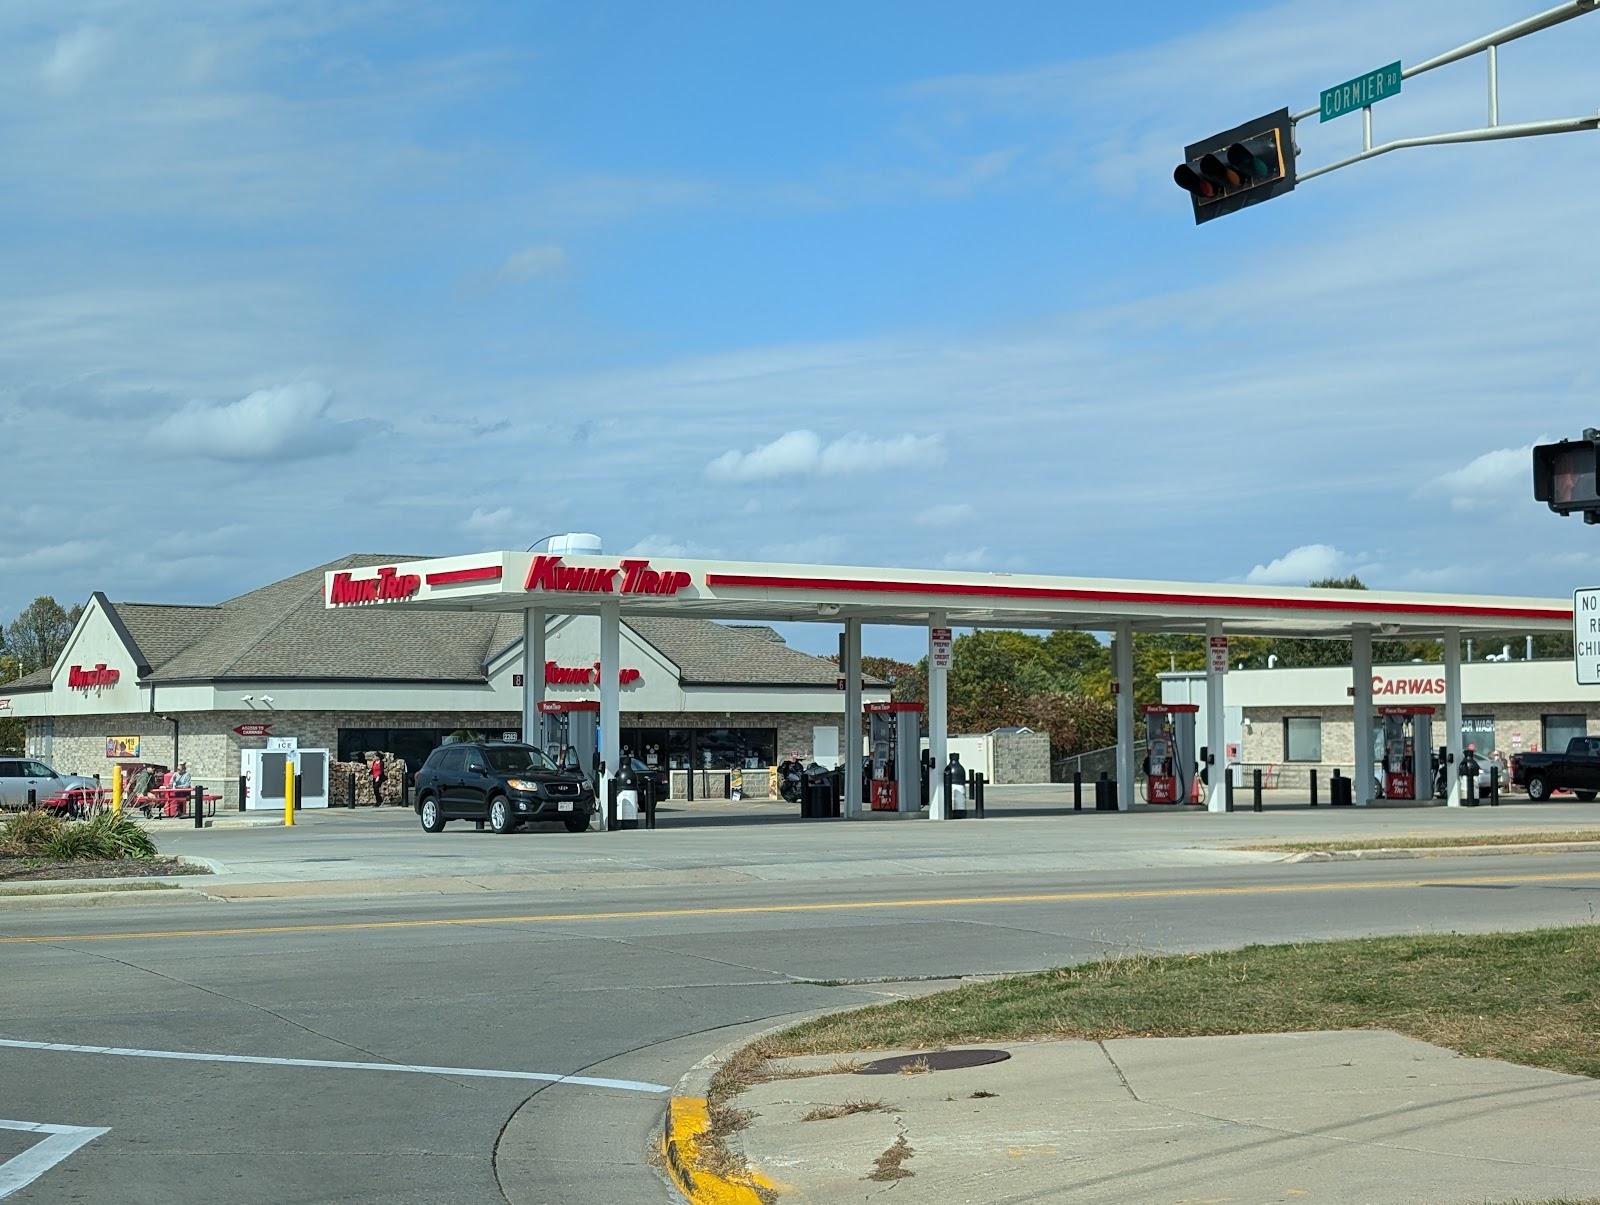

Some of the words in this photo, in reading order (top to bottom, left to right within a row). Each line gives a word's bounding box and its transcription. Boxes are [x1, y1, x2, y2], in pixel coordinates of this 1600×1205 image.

[1325, 73, 1383, 115] CORMIER
[1387, 73, 1397, 86] RD
[330, 572, 379, 604] KWIK
[377, 567, 421, 599] TRIP
[525, 556, 619, 592] KWIK
[619, 560, 692, 595] TRIP
[1582, 595, 1597, 611] NO
